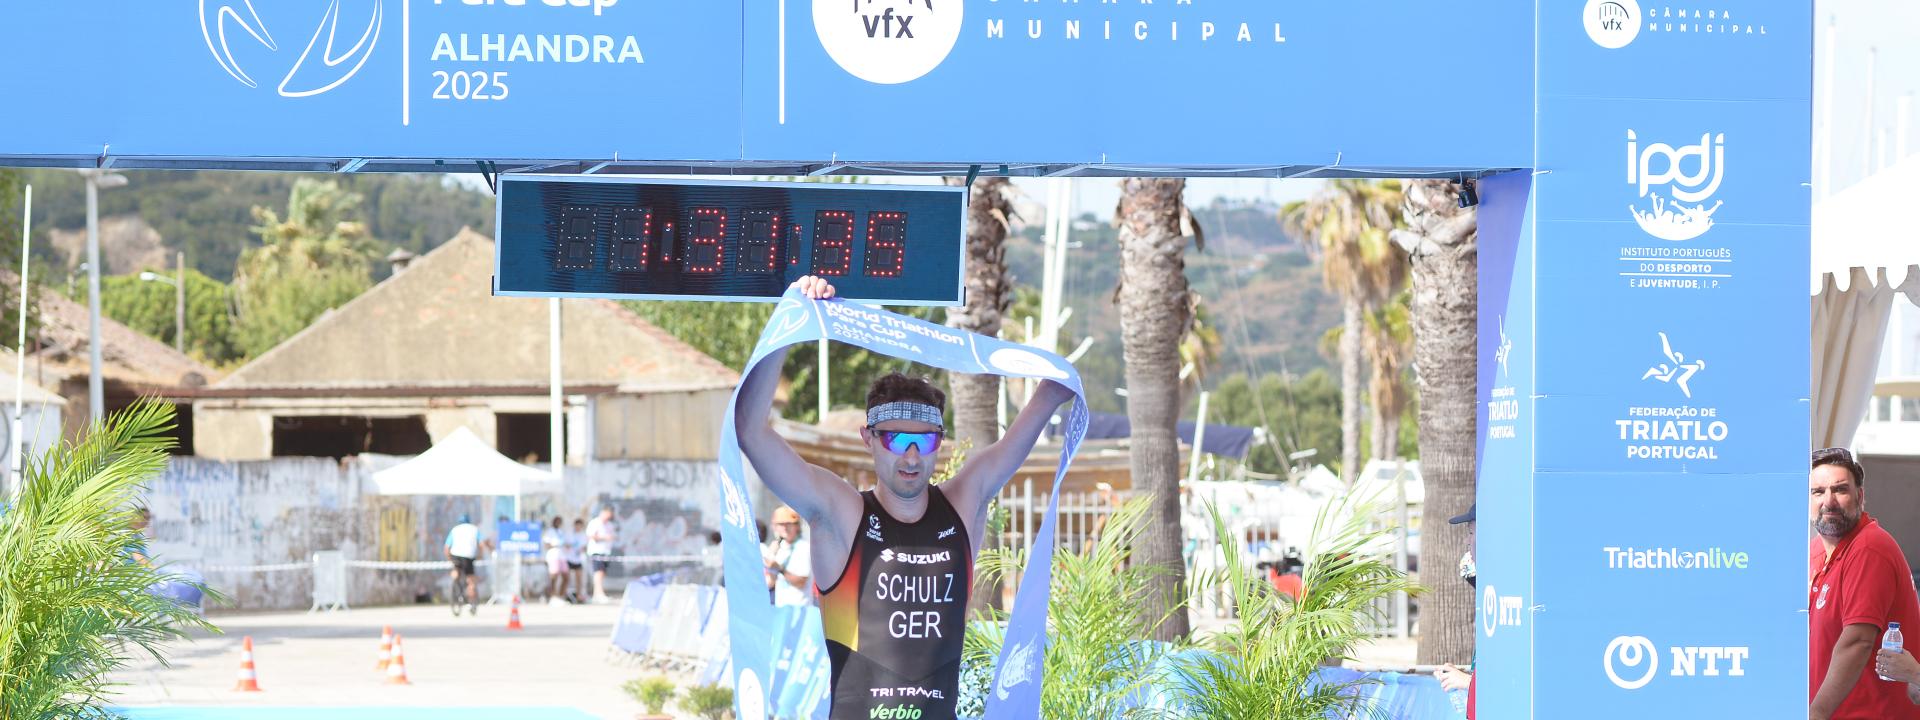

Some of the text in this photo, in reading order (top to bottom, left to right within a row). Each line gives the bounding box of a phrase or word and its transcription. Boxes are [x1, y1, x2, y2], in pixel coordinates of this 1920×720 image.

[1649, 7, 1730, 19] CÂMARA
[861, 14, 914, 39] vfx
[987, 19, 1286, 42] MUNICIPAL
[1603, 19, 1622, 30] vfx
[1649, 23, 1767, 34] MUNICIPAL
[431, 33, 644, 63] ALHANDRA
[432, 71, 509, 100] 2025
[1621, 247, 1731, 258] INSTITUTO PORTUGUÊS
[1640, 263, 1712, 273] DO DESPORTO
[1630, 279, 1635, 288] E
[822, 300, 965, 346] World Triathlon
[826, 308, 906, 339] Para Cup
[1488, 399, 1519, 421] TRIATLO
[1629, 405, 1716, 419] FEDERAÇÃO DE
[1616, 420, 1728, 441] TRIATLO
[1627, 445, 1718, 460] PORTUGAL
[897, 550, 951, 565] SUZUKI
[876, 572, 954, 603] SCHULZ
[1499, 596, 1522, 626] NTT
[888, 610, 942, 638] GER
[1670, 646, 1749, 676] NTT
[870, 686, 944, 699] TRI TRAVEL
[870, 703, 922, 720] Verbio
